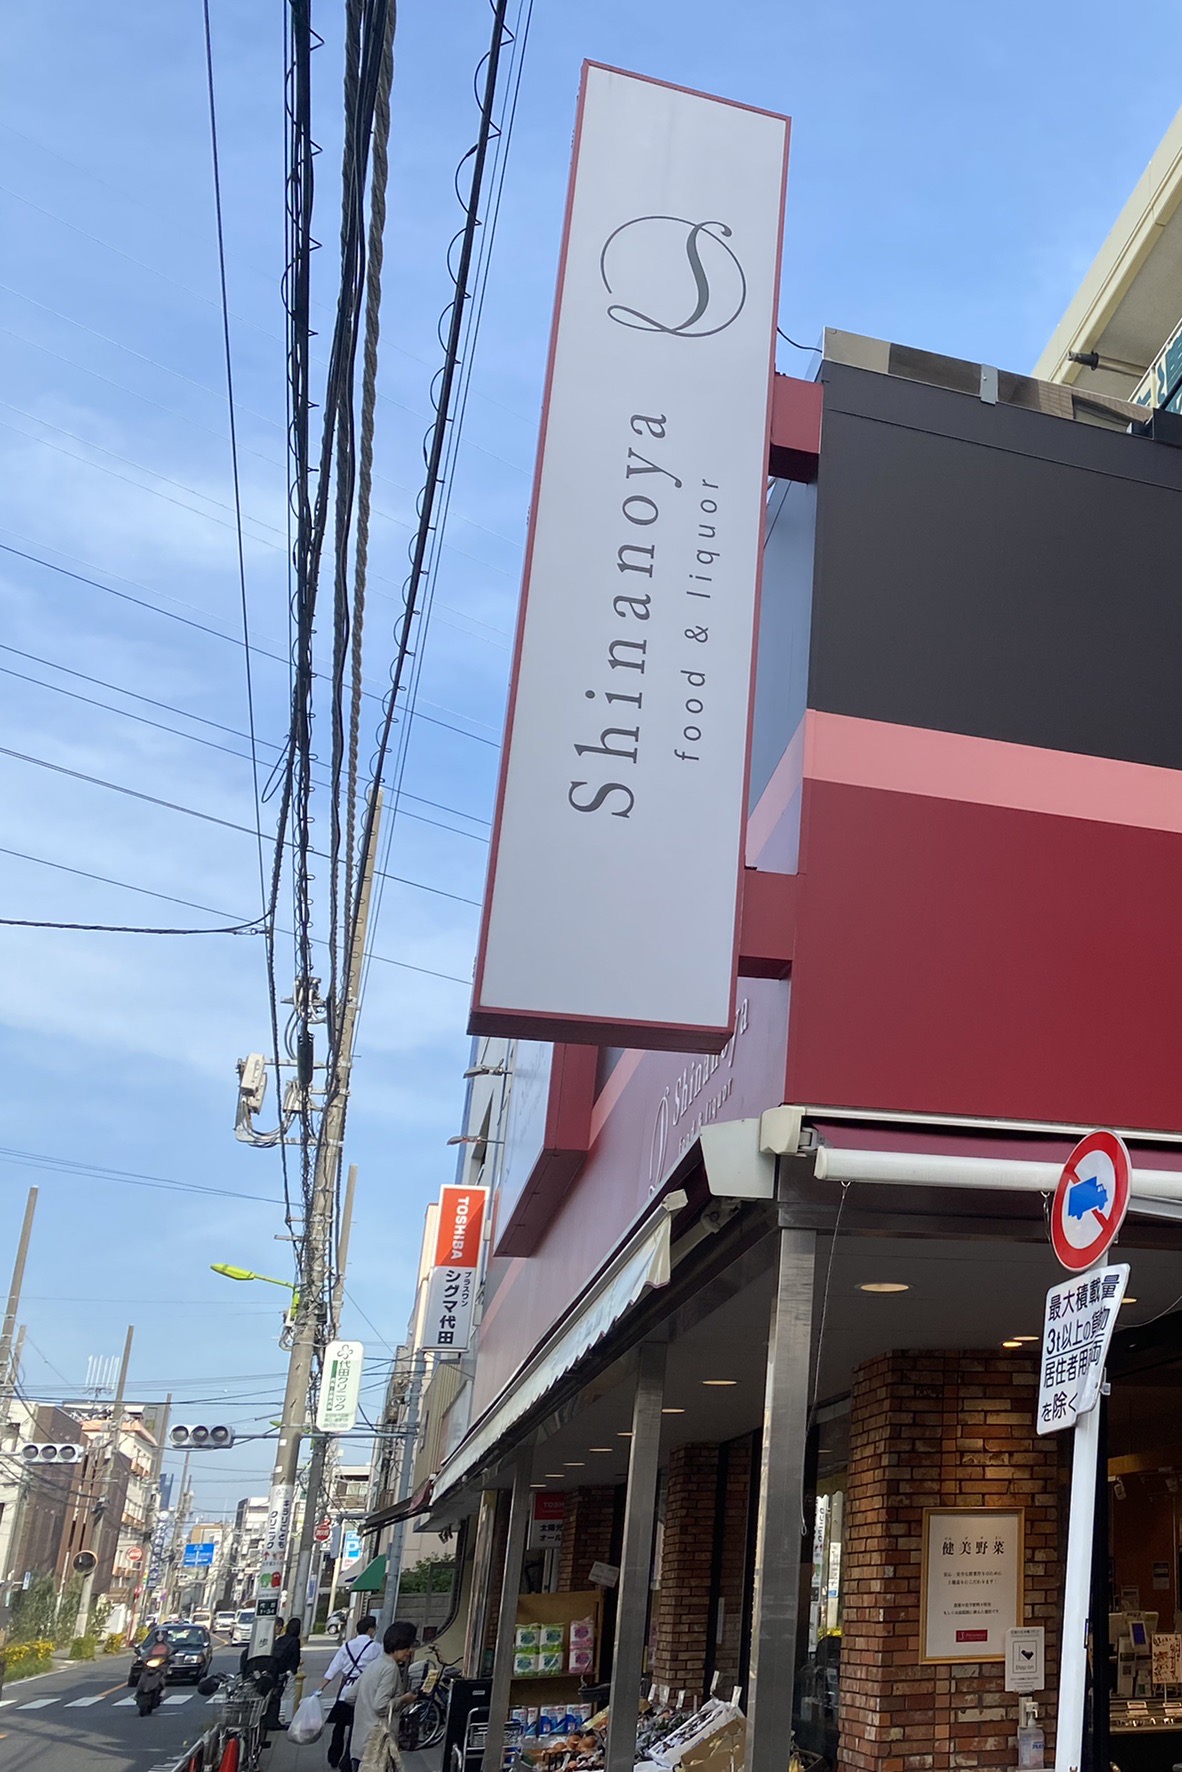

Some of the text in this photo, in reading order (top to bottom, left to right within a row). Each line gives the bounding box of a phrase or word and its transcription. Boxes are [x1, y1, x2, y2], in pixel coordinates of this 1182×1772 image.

[568, 412, 682, 819] Shinanoya
[674, 478, 721, 762] food & liquor
[451, 1196, 470, 1260] TOSHIBA
[437, 1269, 461, 1345] シグマ代田
[1048, 1274, 1120, 1322] 最大積載量
[334, 1360, 351, 1411] 代田クリニック
[1041, 1390, 1079, 1422] を除く
[266, 1510, 279, 1550] クリニック
[942, 1540, 1005, 1555] 健美野菜
